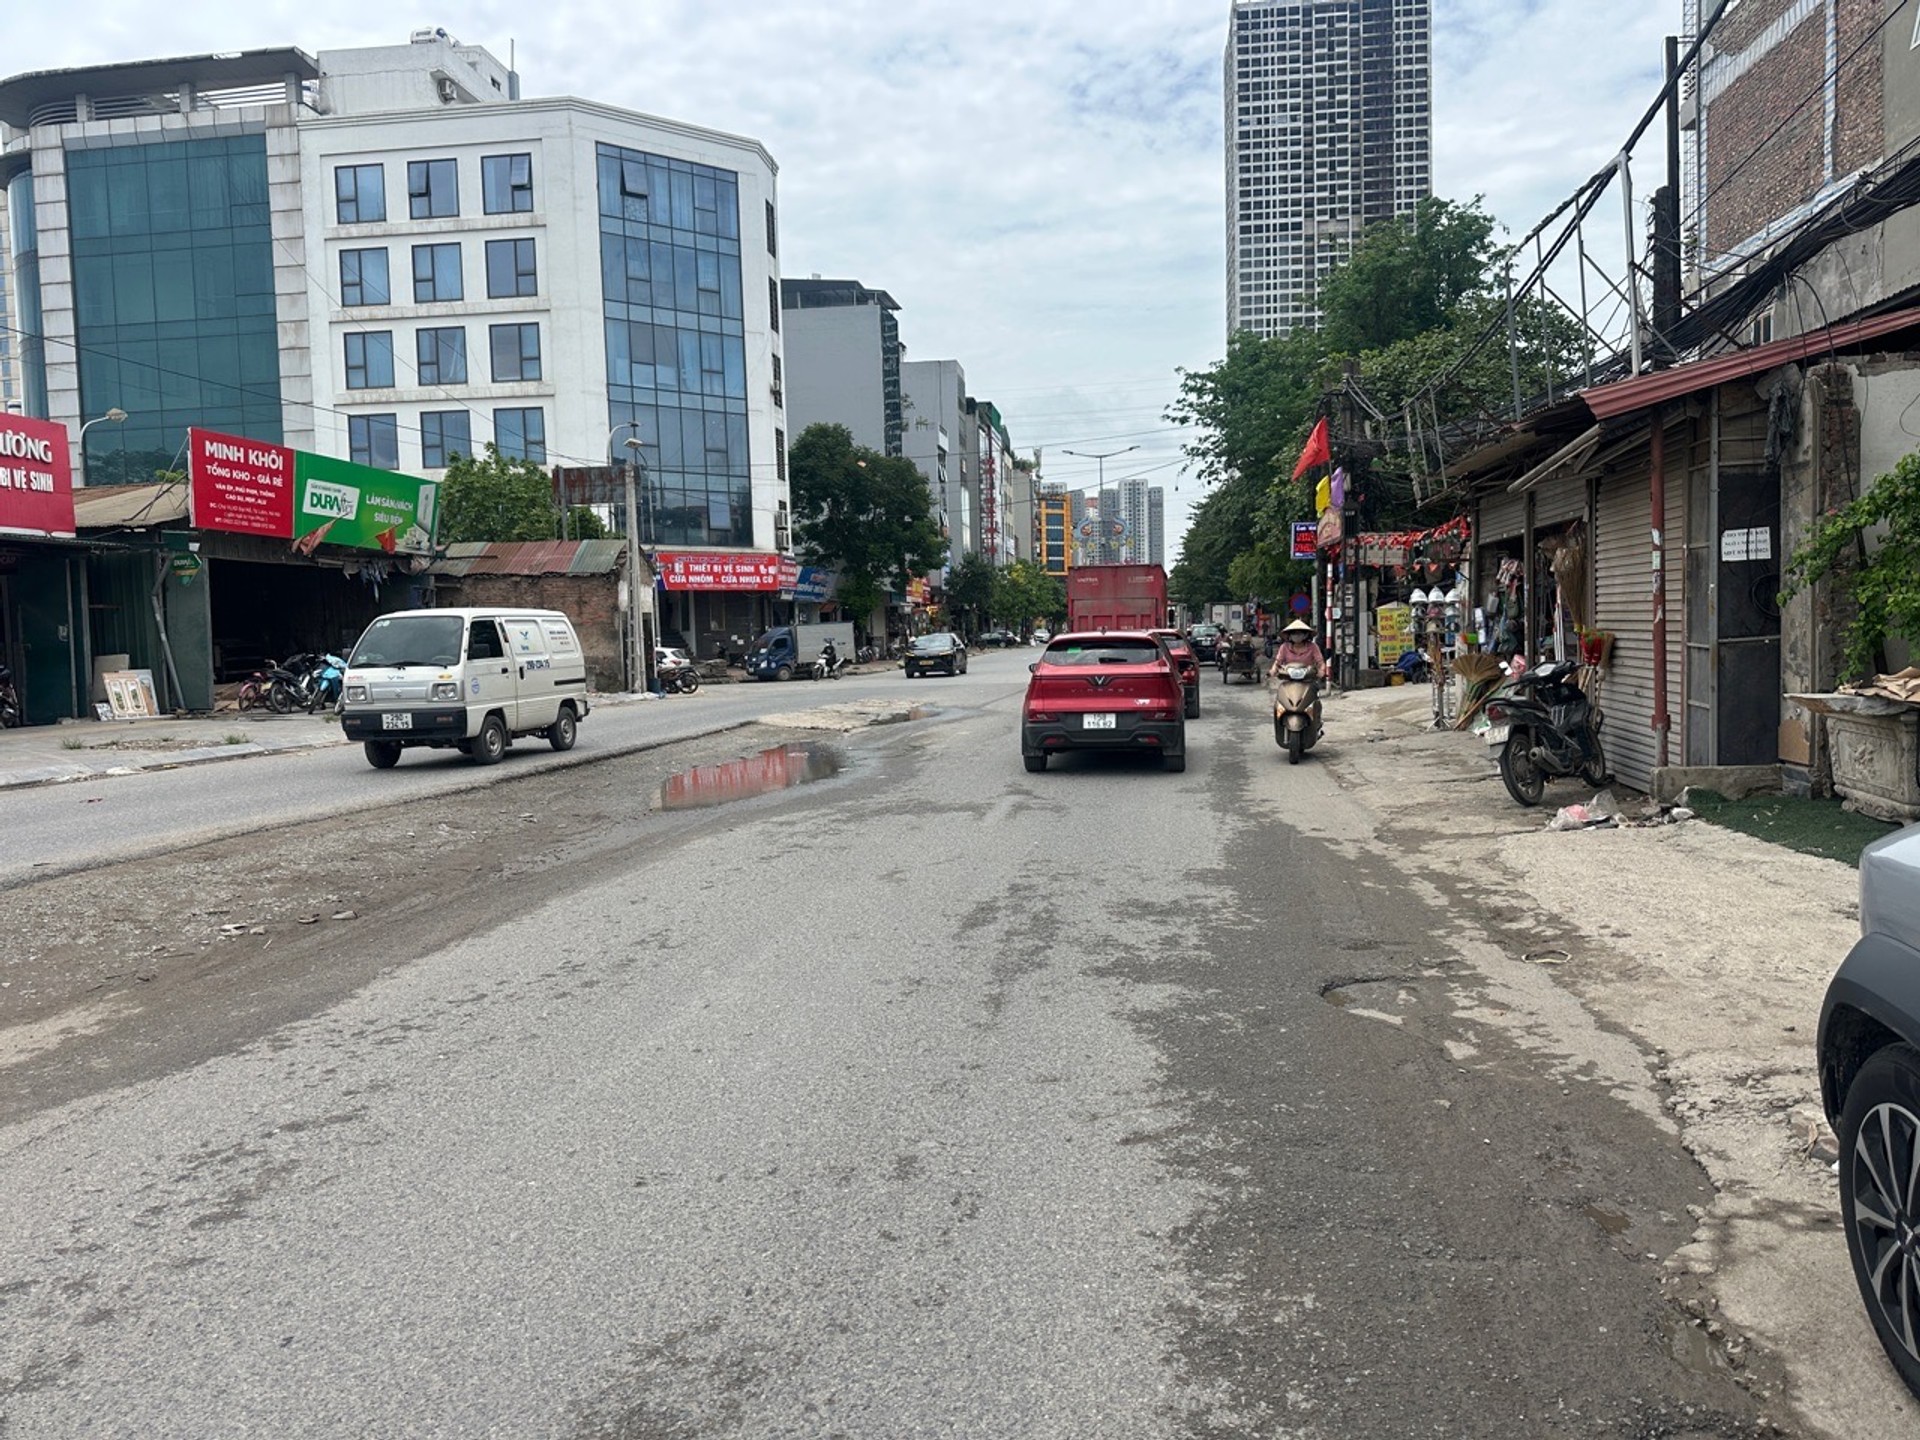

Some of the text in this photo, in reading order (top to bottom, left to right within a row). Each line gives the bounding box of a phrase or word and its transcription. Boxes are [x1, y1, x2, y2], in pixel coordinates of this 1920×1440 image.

[205, 440, 284, 470] MINH KHÔI
[13, 466, 27, 492] VỆ
[30, 470, 54, 492] SINH
[206, 461, 231, 478] TỔNG
[232, 469, 250, 481] KHO
[257, 473, 271, 485] GIÁ
[273, 474, 283, 487] RẺ
[669, 573, 686, 583] CỬA
[688, 574, 714, 583] NHÔM
[722, 573, 737, 583] CỬA
[739, 575, 761, 585] NHỰA
[689, 561, 755, 575] THIẾT BỊ VỆ SINH
